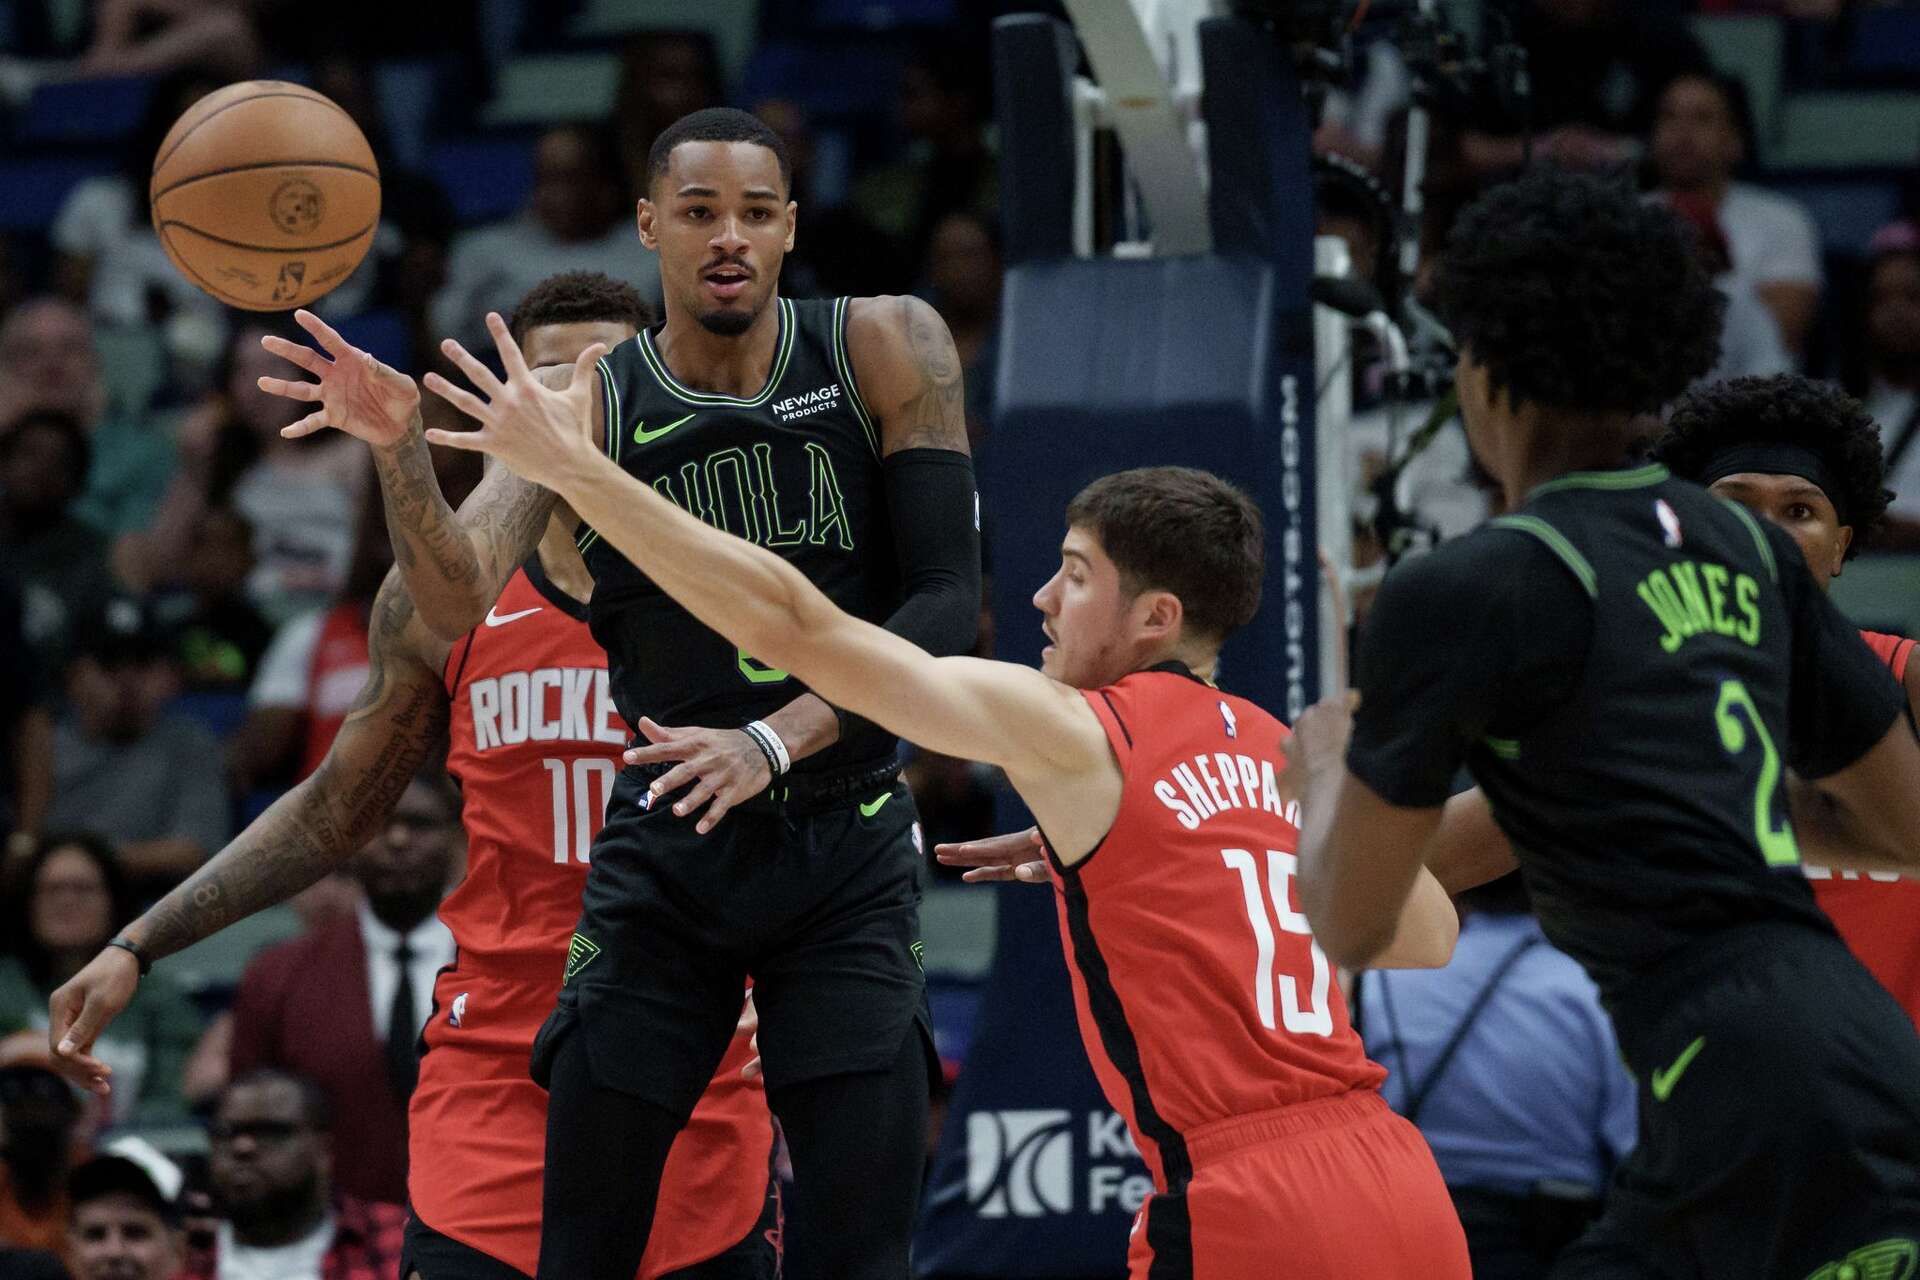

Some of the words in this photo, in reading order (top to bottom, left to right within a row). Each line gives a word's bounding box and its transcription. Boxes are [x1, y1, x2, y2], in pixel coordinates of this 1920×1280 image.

[772, 384, 840, 414] NEWAGE
[782, 400, 837, 421] PRODUCTS
[1636, 560, 1760, 653] JONES
[543, 758, 616, 864] 10
[1715, 679, 1800, 867] 2
[1220, 848, 1333, 1037] 15
